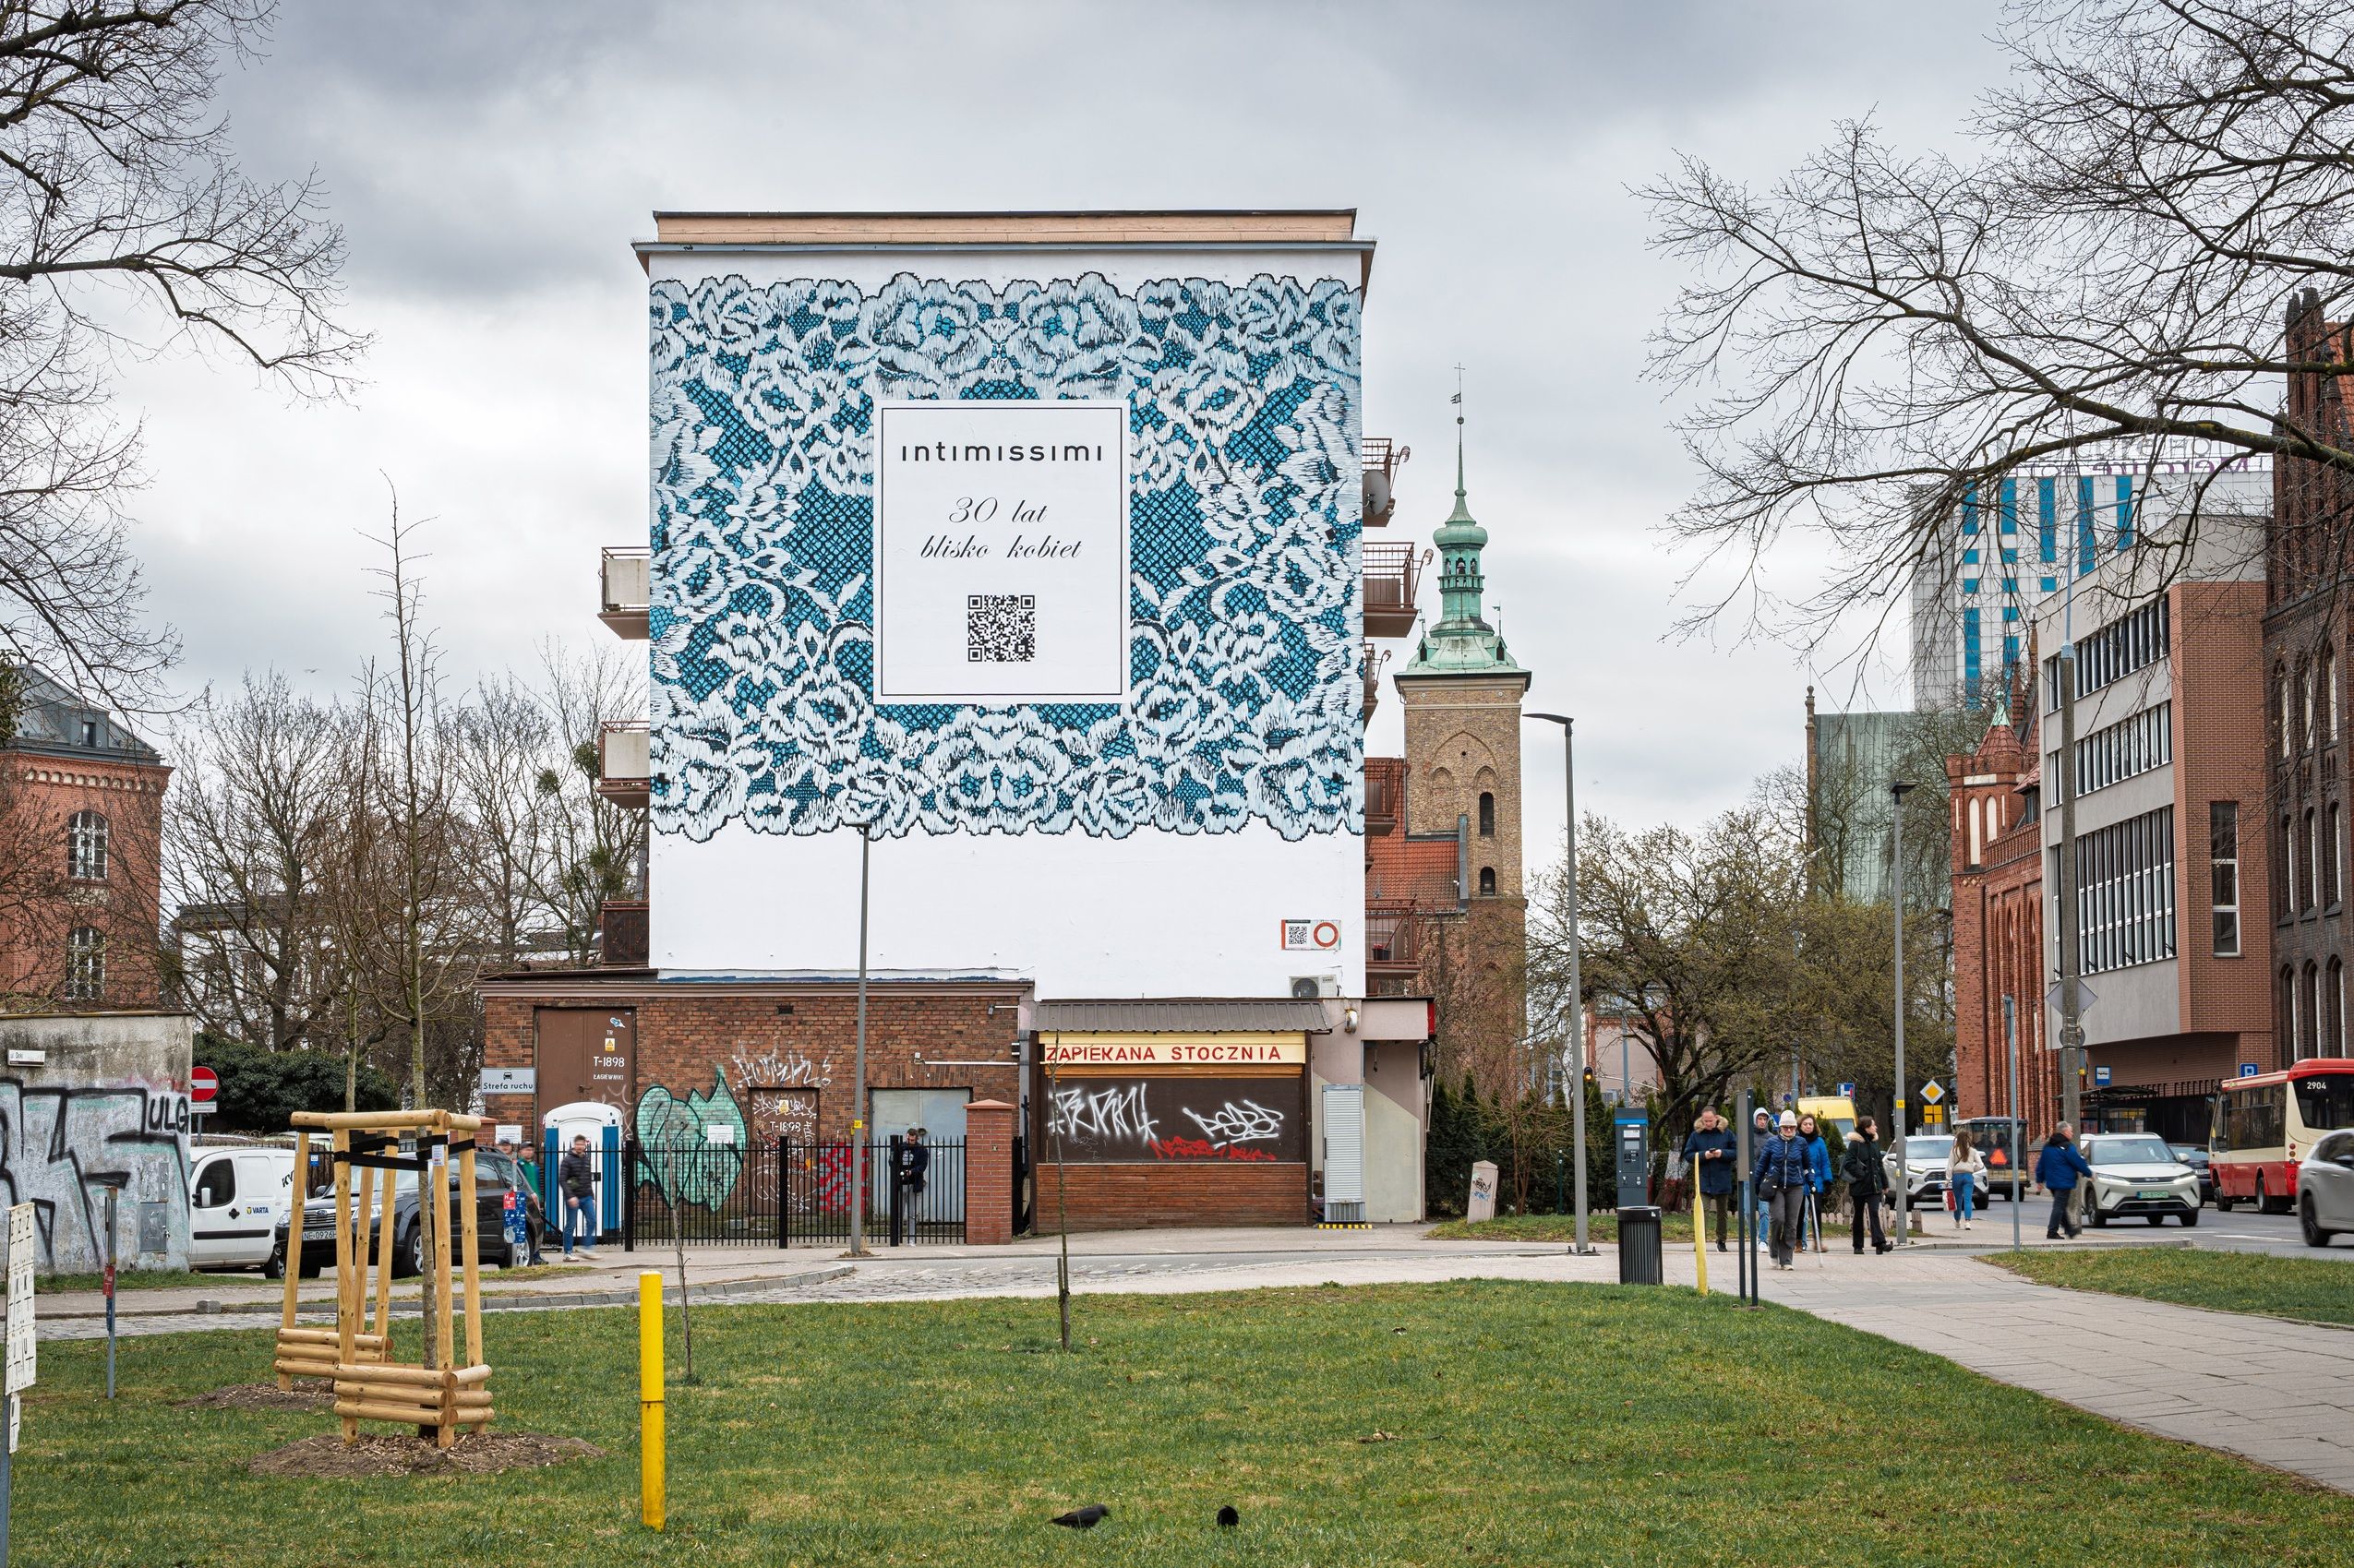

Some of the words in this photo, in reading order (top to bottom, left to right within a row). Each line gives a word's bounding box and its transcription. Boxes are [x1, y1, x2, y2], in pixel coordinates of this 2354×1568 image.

[902, 441, 1102, 461] intimissimi
[948, 497, 998, 523] 30
[1012, 499, 1048, 523] lat
[920, 534, 991, 558] blisko
[1006, 534, 1082, 558] kobiet
[1046, 1047, 1156, 1061] ZAPIEKANA
[1171, 1046, 1281, 1060] STOCZNIA
[594, 1057, 625, 1068] T-1898
[483, 1082, 509, 1090] Strefa
[510, 1082, 534, 1090] ruchu
[2307, 1082, 2326, 1090] 2904
[770, 1121, 801, 1132] T-1898
[252, 1206, 269, 1215] VARTA
